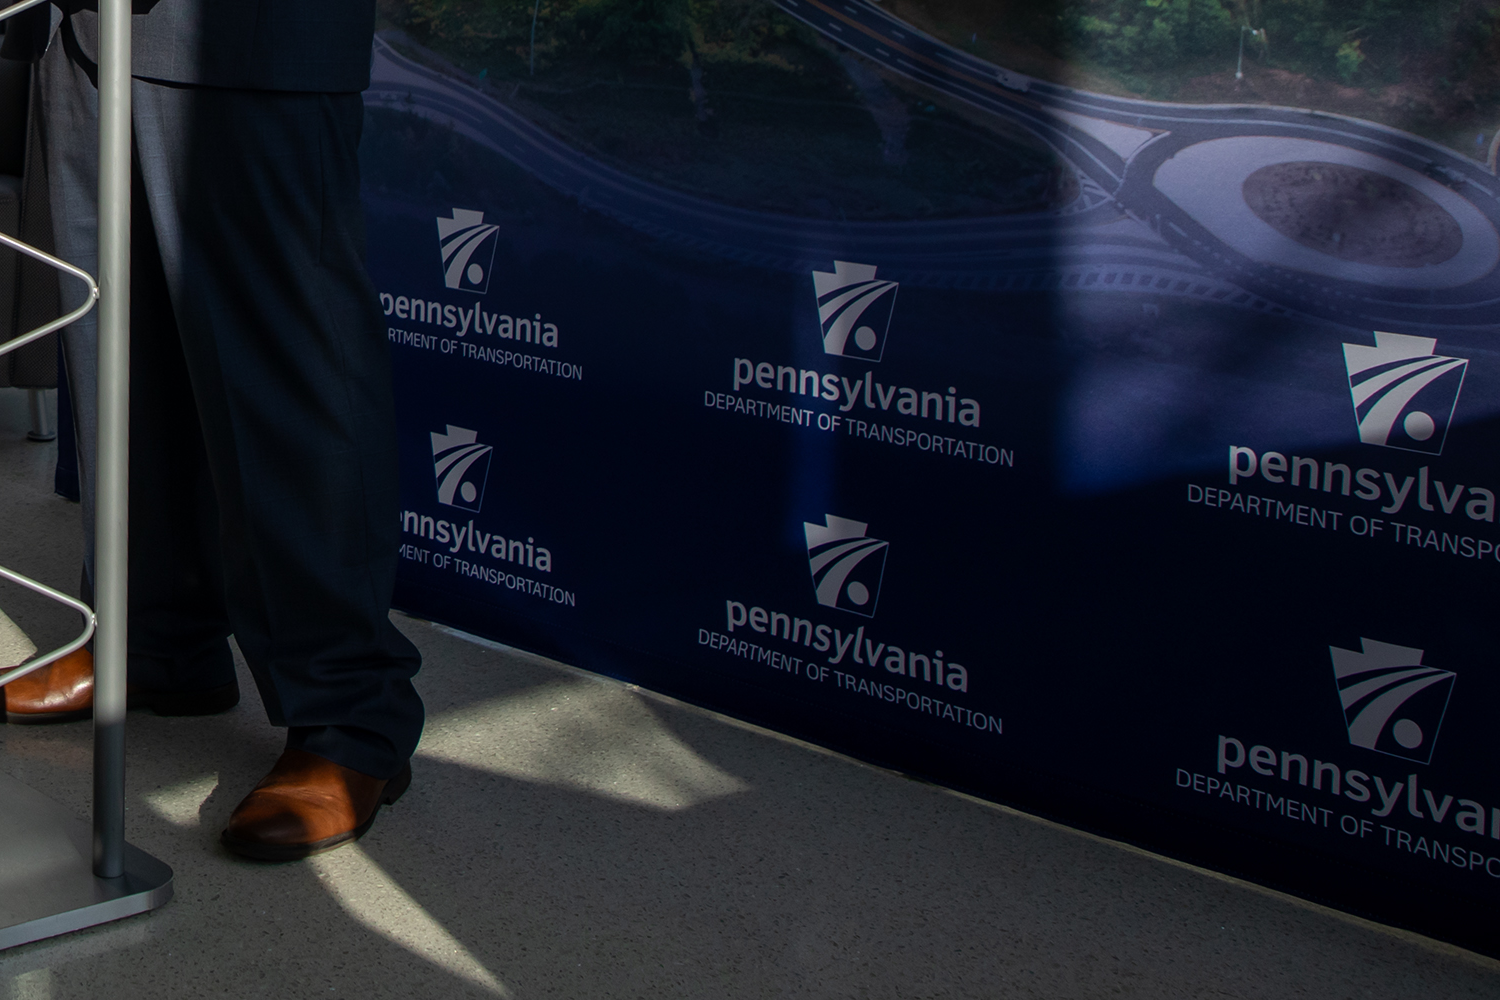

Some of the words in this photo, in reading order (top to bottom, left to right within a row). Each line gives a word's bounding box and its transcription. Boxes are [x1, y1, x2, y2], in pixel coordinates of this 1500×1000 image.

[379, 291, 559, 348] pennsylvania
[387, 327, 438, 350] RTMENT
[440, 338, 458, 355] OF
[460, 342, 583, 381] TRANSPORTATION
[703, 390, 814, 427] DEPARTMENT
[817, 413, 842, 432] OF
[845, 418, 1014, 468] TRANSPORTATION
[733, 357, 981, 428] pennsylvania
[1187, 483, 1343, 531] DEPARTMENT
[1349, 515, 1384, 538] OF
[1228, 444, 1500, 523] pennsylva
[400, 510, 552, 573] nnsylvania
[433, 552, 452, 570] OF
[454, 558, 576, 607] TRANSPORTATION
[697, 628, 803, 675] DEPARTMENT
[806, 663, 830, 682] OF
[833, 670, 1003, 735] TRANSPORTATION
[726, 599, 969, 693] pennsylvania
[1176, 768, 1334, 828] DEPARTMENT
[1340, 814, 1374, 838] OF
[1380, 824, 1500, 878] TRANSPO
[1217, 734, 1500, 840] pennsylva
